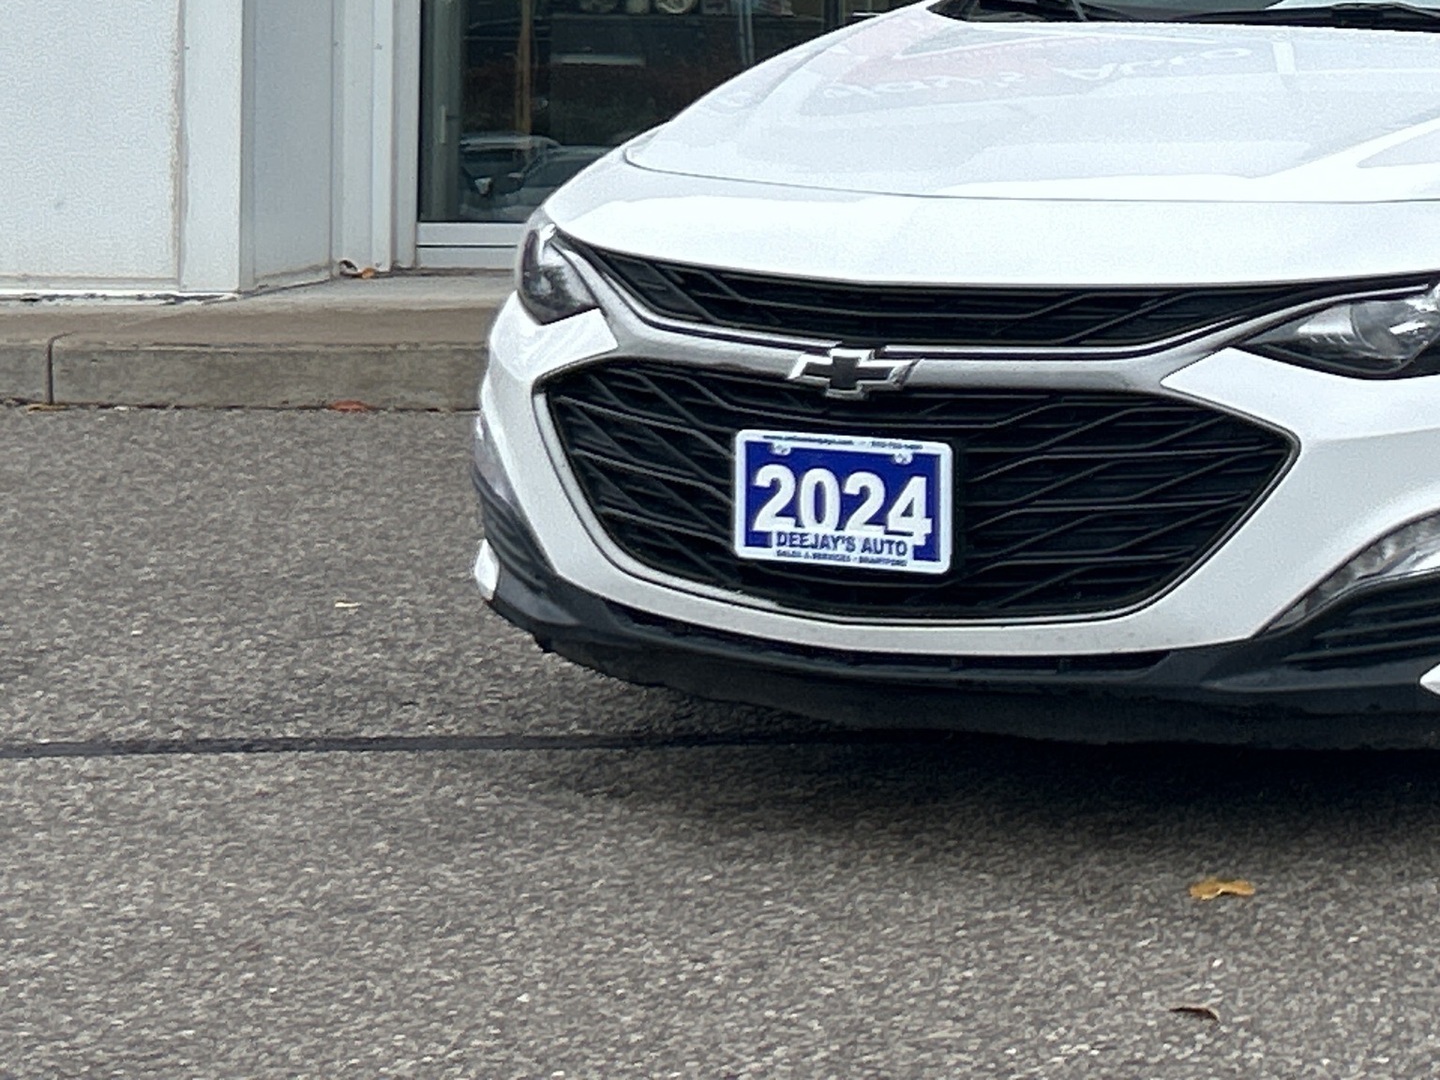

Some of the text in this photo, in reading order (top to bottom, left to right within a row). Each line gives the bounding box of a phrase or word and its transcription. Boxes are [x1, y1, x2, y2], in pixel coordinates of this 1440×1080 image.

[752, 462, 934, 546] 2024
[776, 530, 908, 557] DEEJAY'S AUTO
